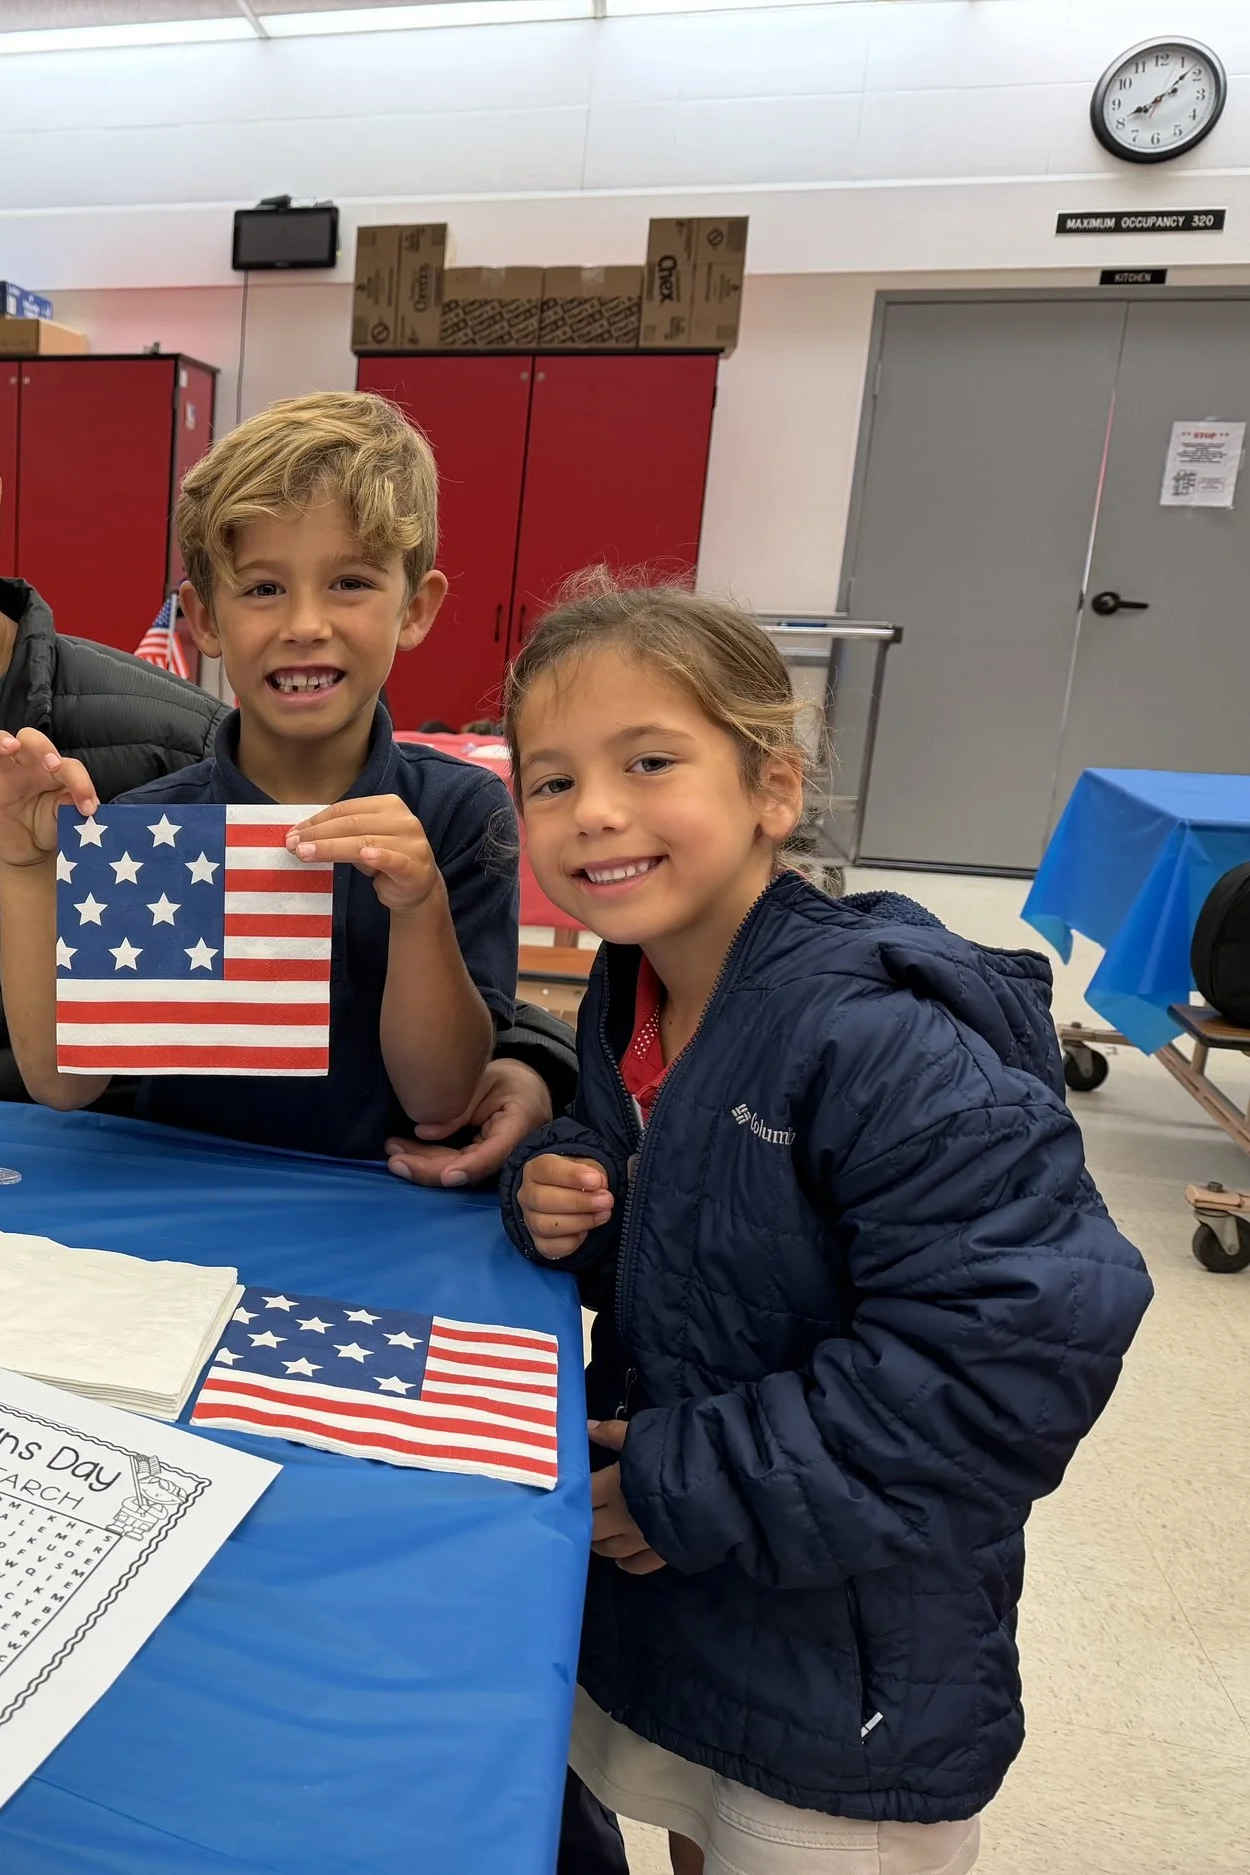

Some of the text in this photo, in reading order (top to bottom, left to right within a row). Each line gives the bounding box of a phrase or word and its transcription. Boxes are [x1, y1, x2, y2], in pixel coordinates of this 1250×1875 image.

[1154, 53, 1170, 66] 12
[1180, 56, 1185, 68] 1
[1135, 61, 1146, 73] 11
[1192, 69, 1202, 81] 2
[1119, 78, 1132, 90] 10
[1196, 88, 1205, 100] 3
[1112, 99, 1122, 111] 9
[1188, 109, 1198, 121] 4
[1116, 118, 1125, 130] 8
[1131, 130, 1140, 142] 7
[1173, 125, 1183, 137] 5
[1151, 133, 1160, 145] 6
[1066, 215, 1214, 229] MAXIMUM OCCUPANCY 320
[1115, 272, 1151, 283] KITCHEN
[46, 1446, 122, 1492] Day
